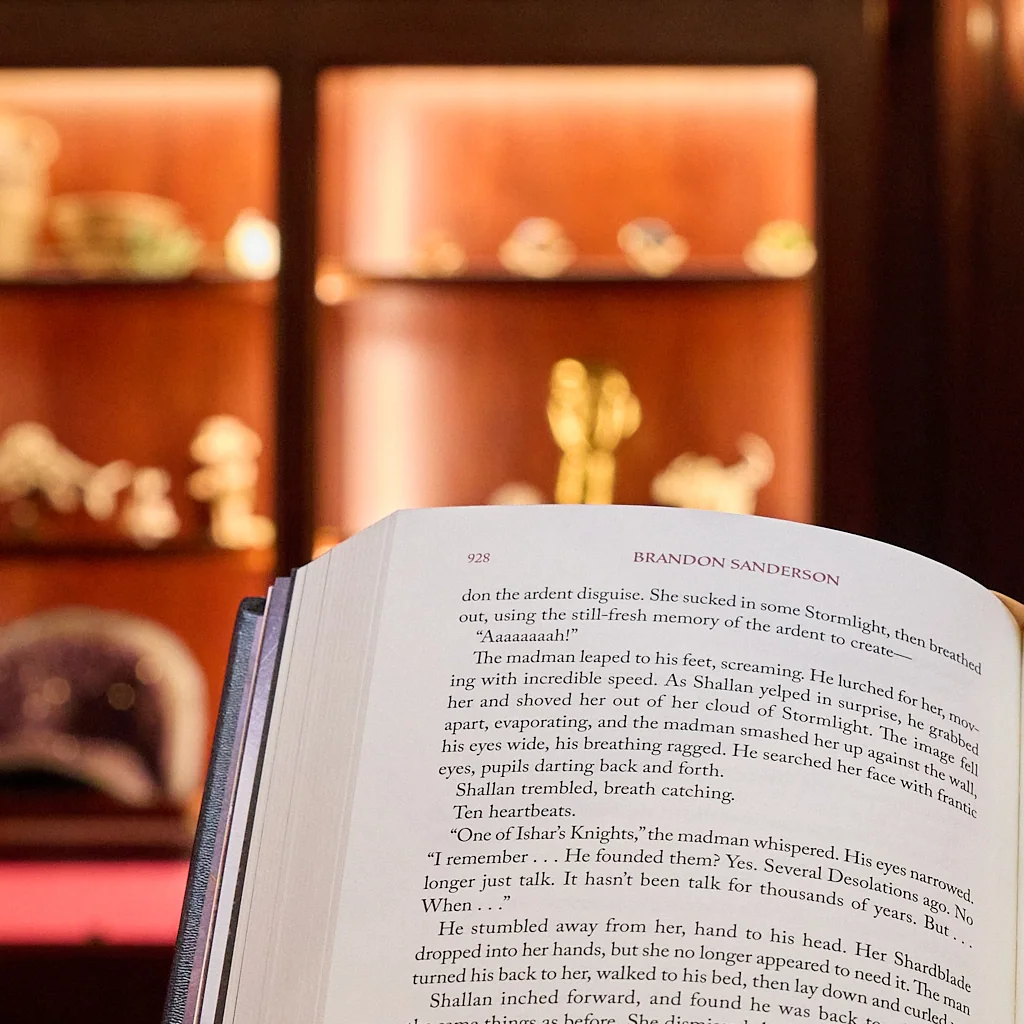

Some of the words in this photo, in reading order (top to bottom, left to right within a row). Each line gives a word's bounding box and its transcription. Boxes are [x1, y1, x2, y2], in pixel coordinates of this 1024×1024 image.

[467, 552, 491, 563] 928
[633, 551, 726, 568] BRANDON
[730, 559, 840, 587] SANDERSON
[461, 588, 491, 602] don
[495, 587, 520, 601] the
[523, 586, 574, 600] ardent
[576, 586, 644, 604] disguise.
[649, 588, 679, 603] She
[682, 592, 737, 608] sucked
[741, 596, 756, 610] in
[760, 602, 801, 617] some
[804, 605, 891, 639] Stormlight,
[894, 628, 926, 649] then
[929, 638, 982, 676] breathed
[450, 674, 477, 691] ing
[480, 671, 517, 686] with
[523, 670, 602, 685] incredible
[607, 672, 658, 690] speed.
[663, 673, 687, 688] As
[693, 674, 754, 694] Shallan
[758, 684, 811, 703] yelped
[816, 691, 832, 706] in
[838, 699, 902, 726] surprise,
[907, 713, 925, 731] he
[928, 725, 979, 757] grabbed
[438, 765, 476, 780] eyes,
[480, 758, 530, 779] pupils
[534, 758, 596, 777] darting
[599, 758, 638, 773] back
[642, 759, 673, 774] and
[677, 760, 724, 778] forth.
[455, 781, 515, 797] Shallan
[521, 780, 598, 797] trembled,
[604, 780, 656, 796] breath
[661, 783, 735, 805] catching.
[452, 804, 483, 820] Ten
[488, 803, 576, 819] heartbeats.
[437, 920, 464, 936] He
[470, 917, 549, 935] stumbled
[555, 922, 599, 938] away
[605, 917, 646, 933] from
[654, 918, 686, 938] her,
[694, 920, 737, 939] hand
[745, 928, 762, 941] to
[769, 927, 795, 945] his
[802, 932, 847, 954] head.
[854, 941, 888, 962] Her
[894, 950, 972, 993] Shardblade
